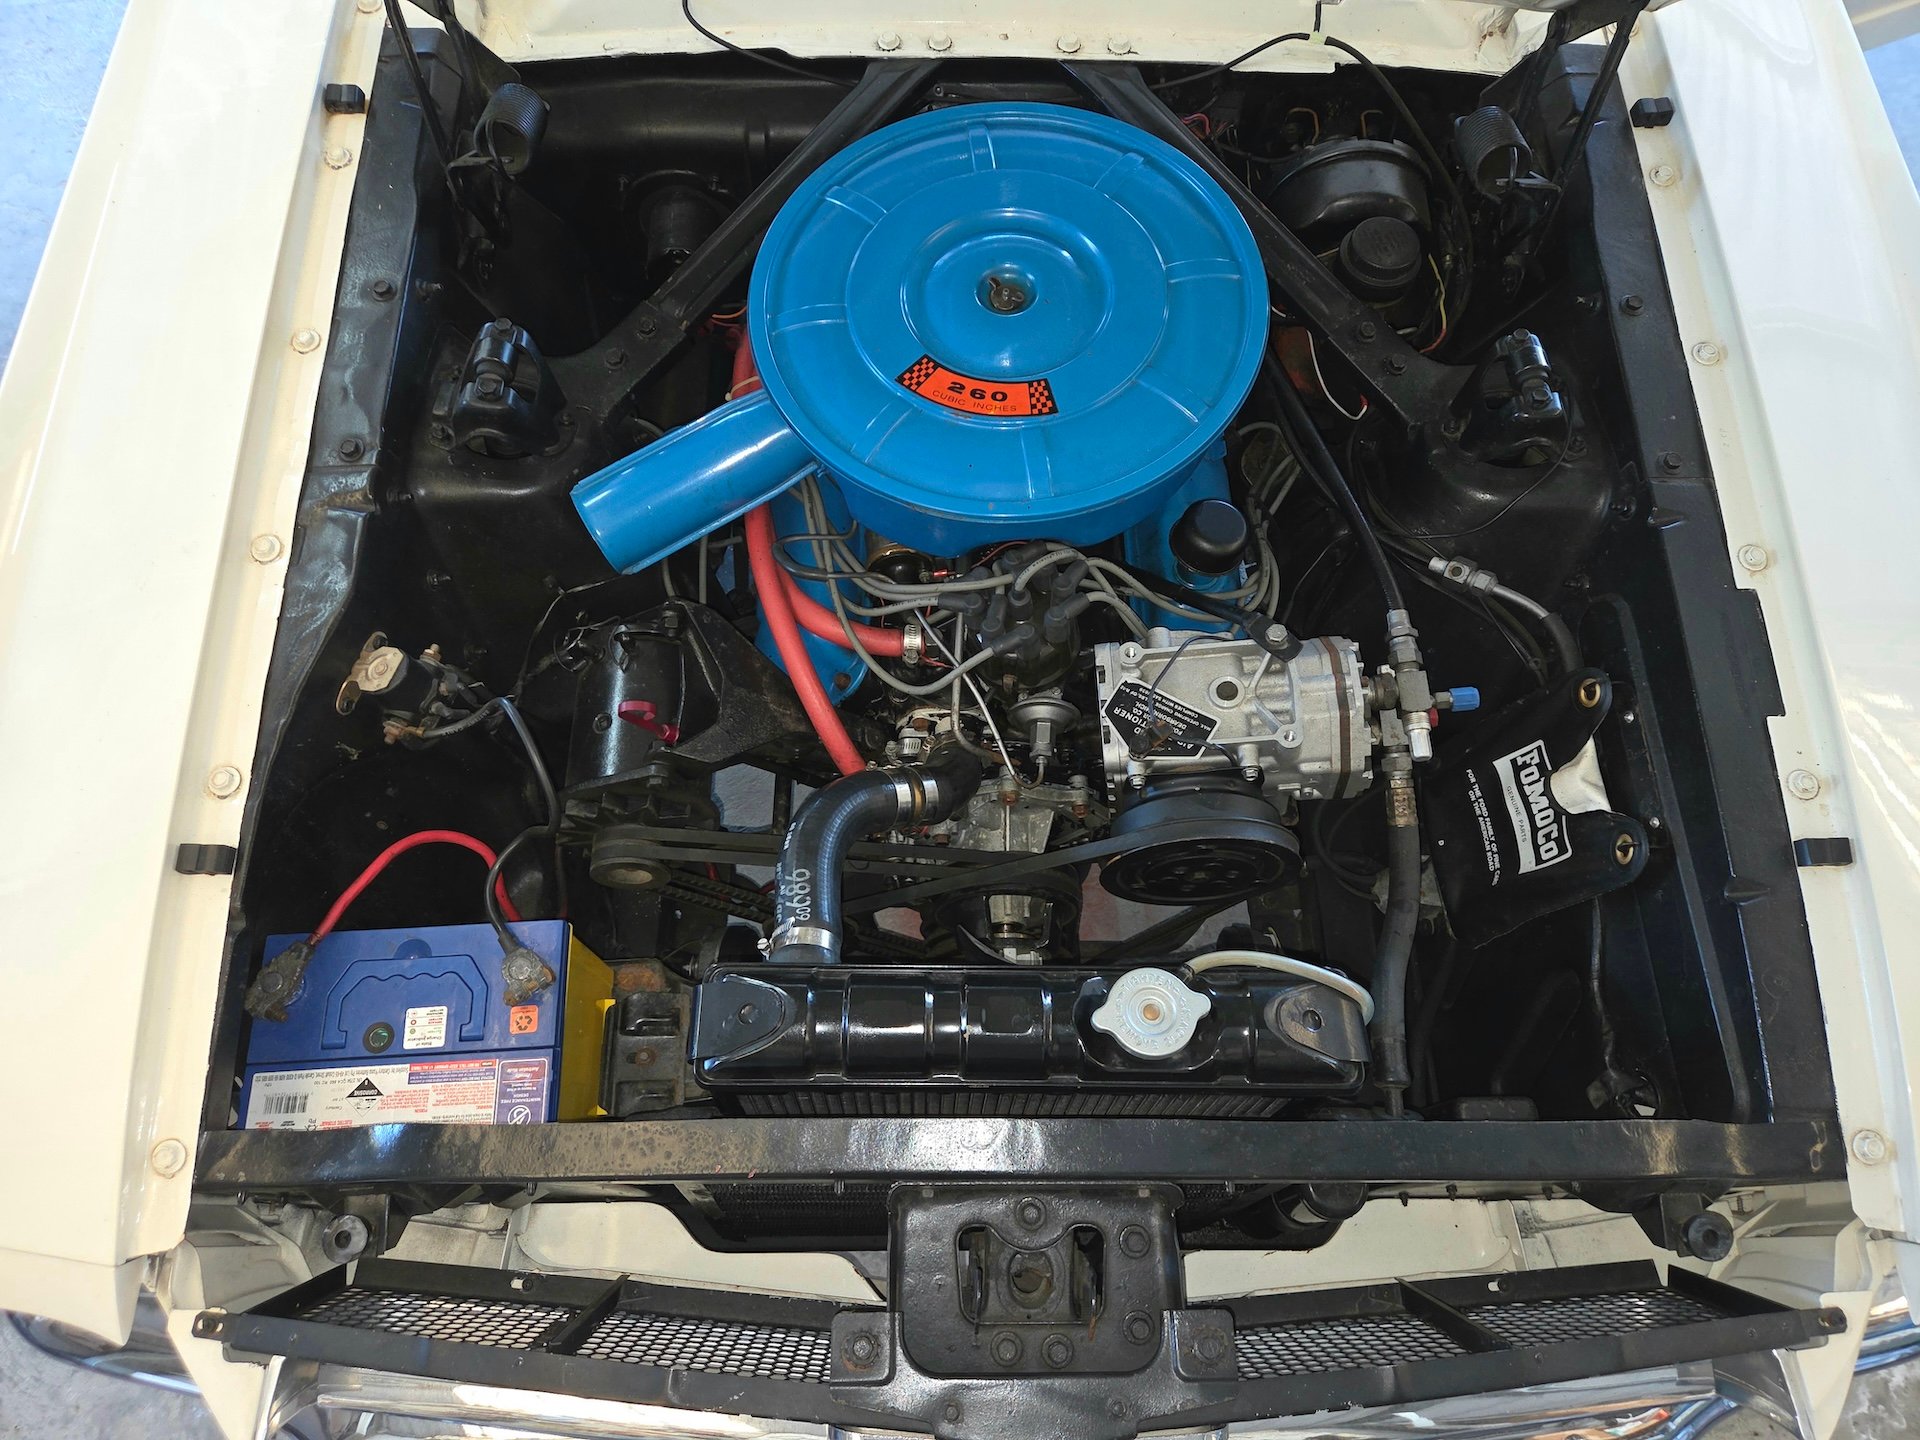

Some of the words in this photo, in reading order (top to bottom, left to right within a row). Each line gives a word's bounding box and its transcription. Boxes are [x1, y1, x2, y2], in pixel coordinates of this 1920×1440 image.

[932, 390, 966, 406] CUBIC
[973, 402, 1017, 412] INCHES
[948, 382, 1008, 402] 260
[1131, 707, 1143, 716] CO.
[1155, 702, 1174, 714] CHARGE
[1172, 703, 1199, 719] COMPLIES
[1174, 711, 1200, 726] OPERATING
[1466, 769, 1476, 783] FOR
[1472, 784, 1482, 798] THE
[1478, 798, 1489, 817] FORD
[1485, 817, 1495, 841] FAMILY
[1491, 843, 1497, 853] OF
[1506, 785, 1521, 818] GENUINE
[1518, 819, 1527, 843] PARTS
[1468, 790, 1476, 801] ON
[1472, 802, 1482, 816] THE
[1478, 816, 1491, 850] AMERICAN
[1486, 851, 1495, 871] ROAD
